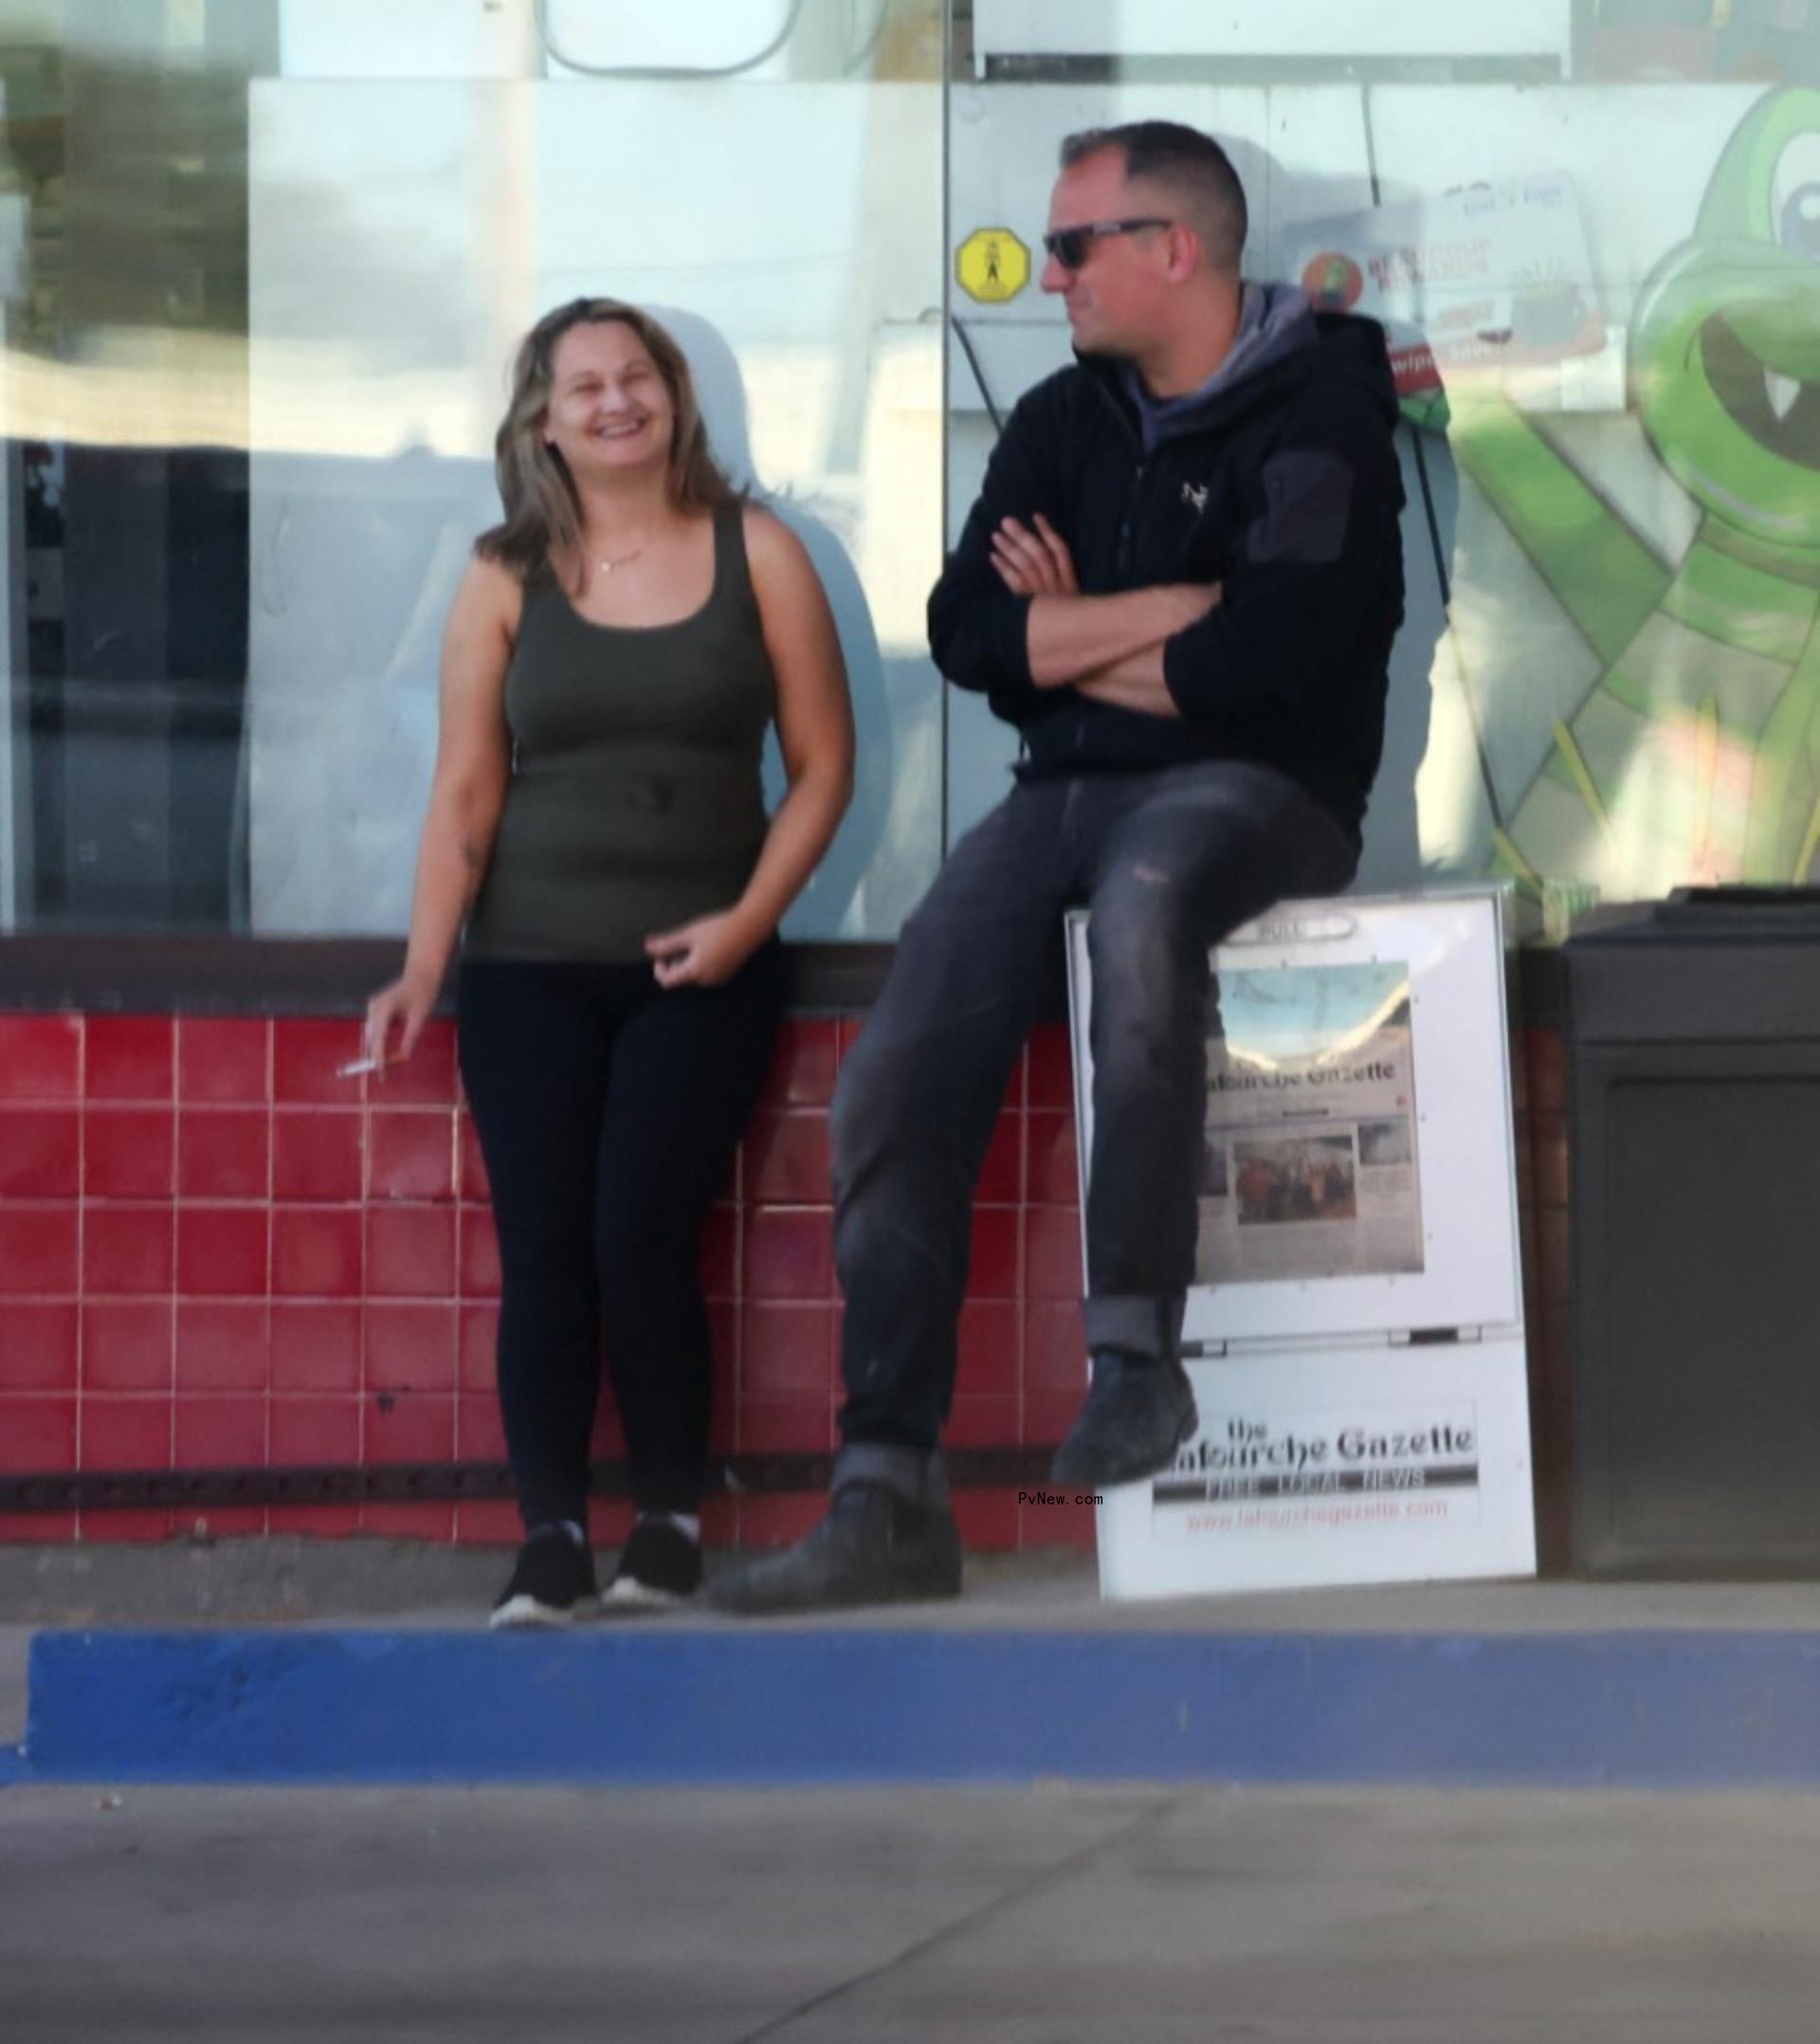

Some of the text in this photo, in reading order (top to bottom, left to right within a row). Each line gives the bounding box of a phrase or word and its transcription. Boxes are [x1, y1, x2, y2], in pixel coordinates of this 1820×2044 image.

[1176, 1424, 1474, 1474] afourche Gazette
[1362, 1467, 1425, 1492] NEWS
